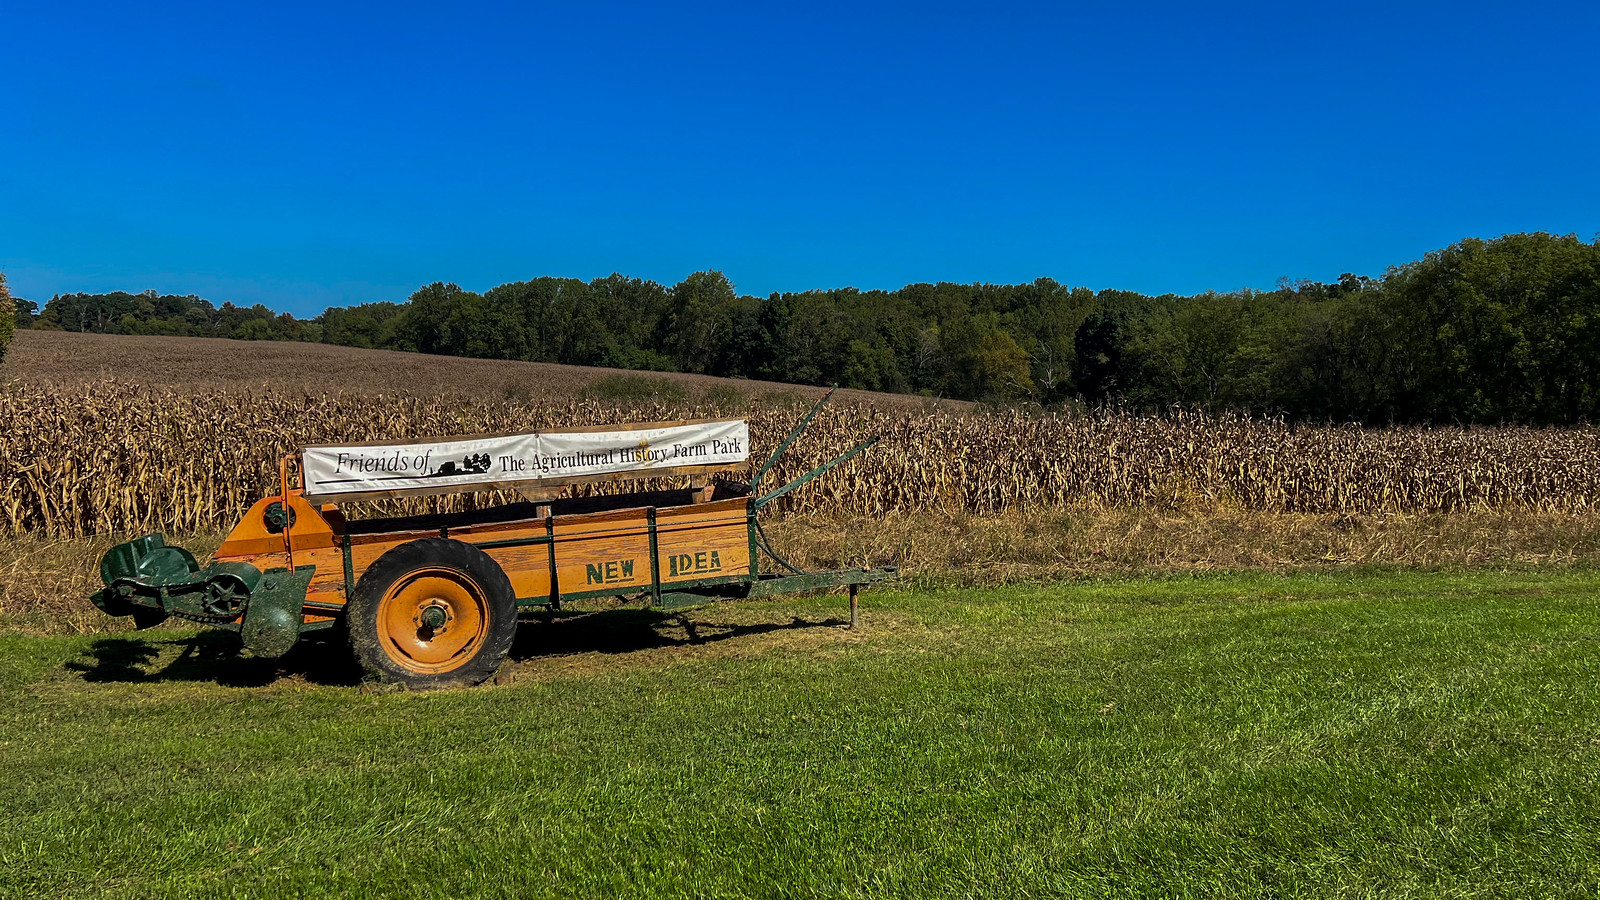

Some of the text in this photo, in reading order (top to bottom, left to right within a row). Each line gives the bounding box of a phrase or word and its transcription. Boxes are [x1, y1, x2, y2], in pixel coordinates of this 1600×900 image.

[335, 438, 742, 475] Friends of The Agricultural History Farm Park
[585, 550, 722, 585] NEW IDEA
